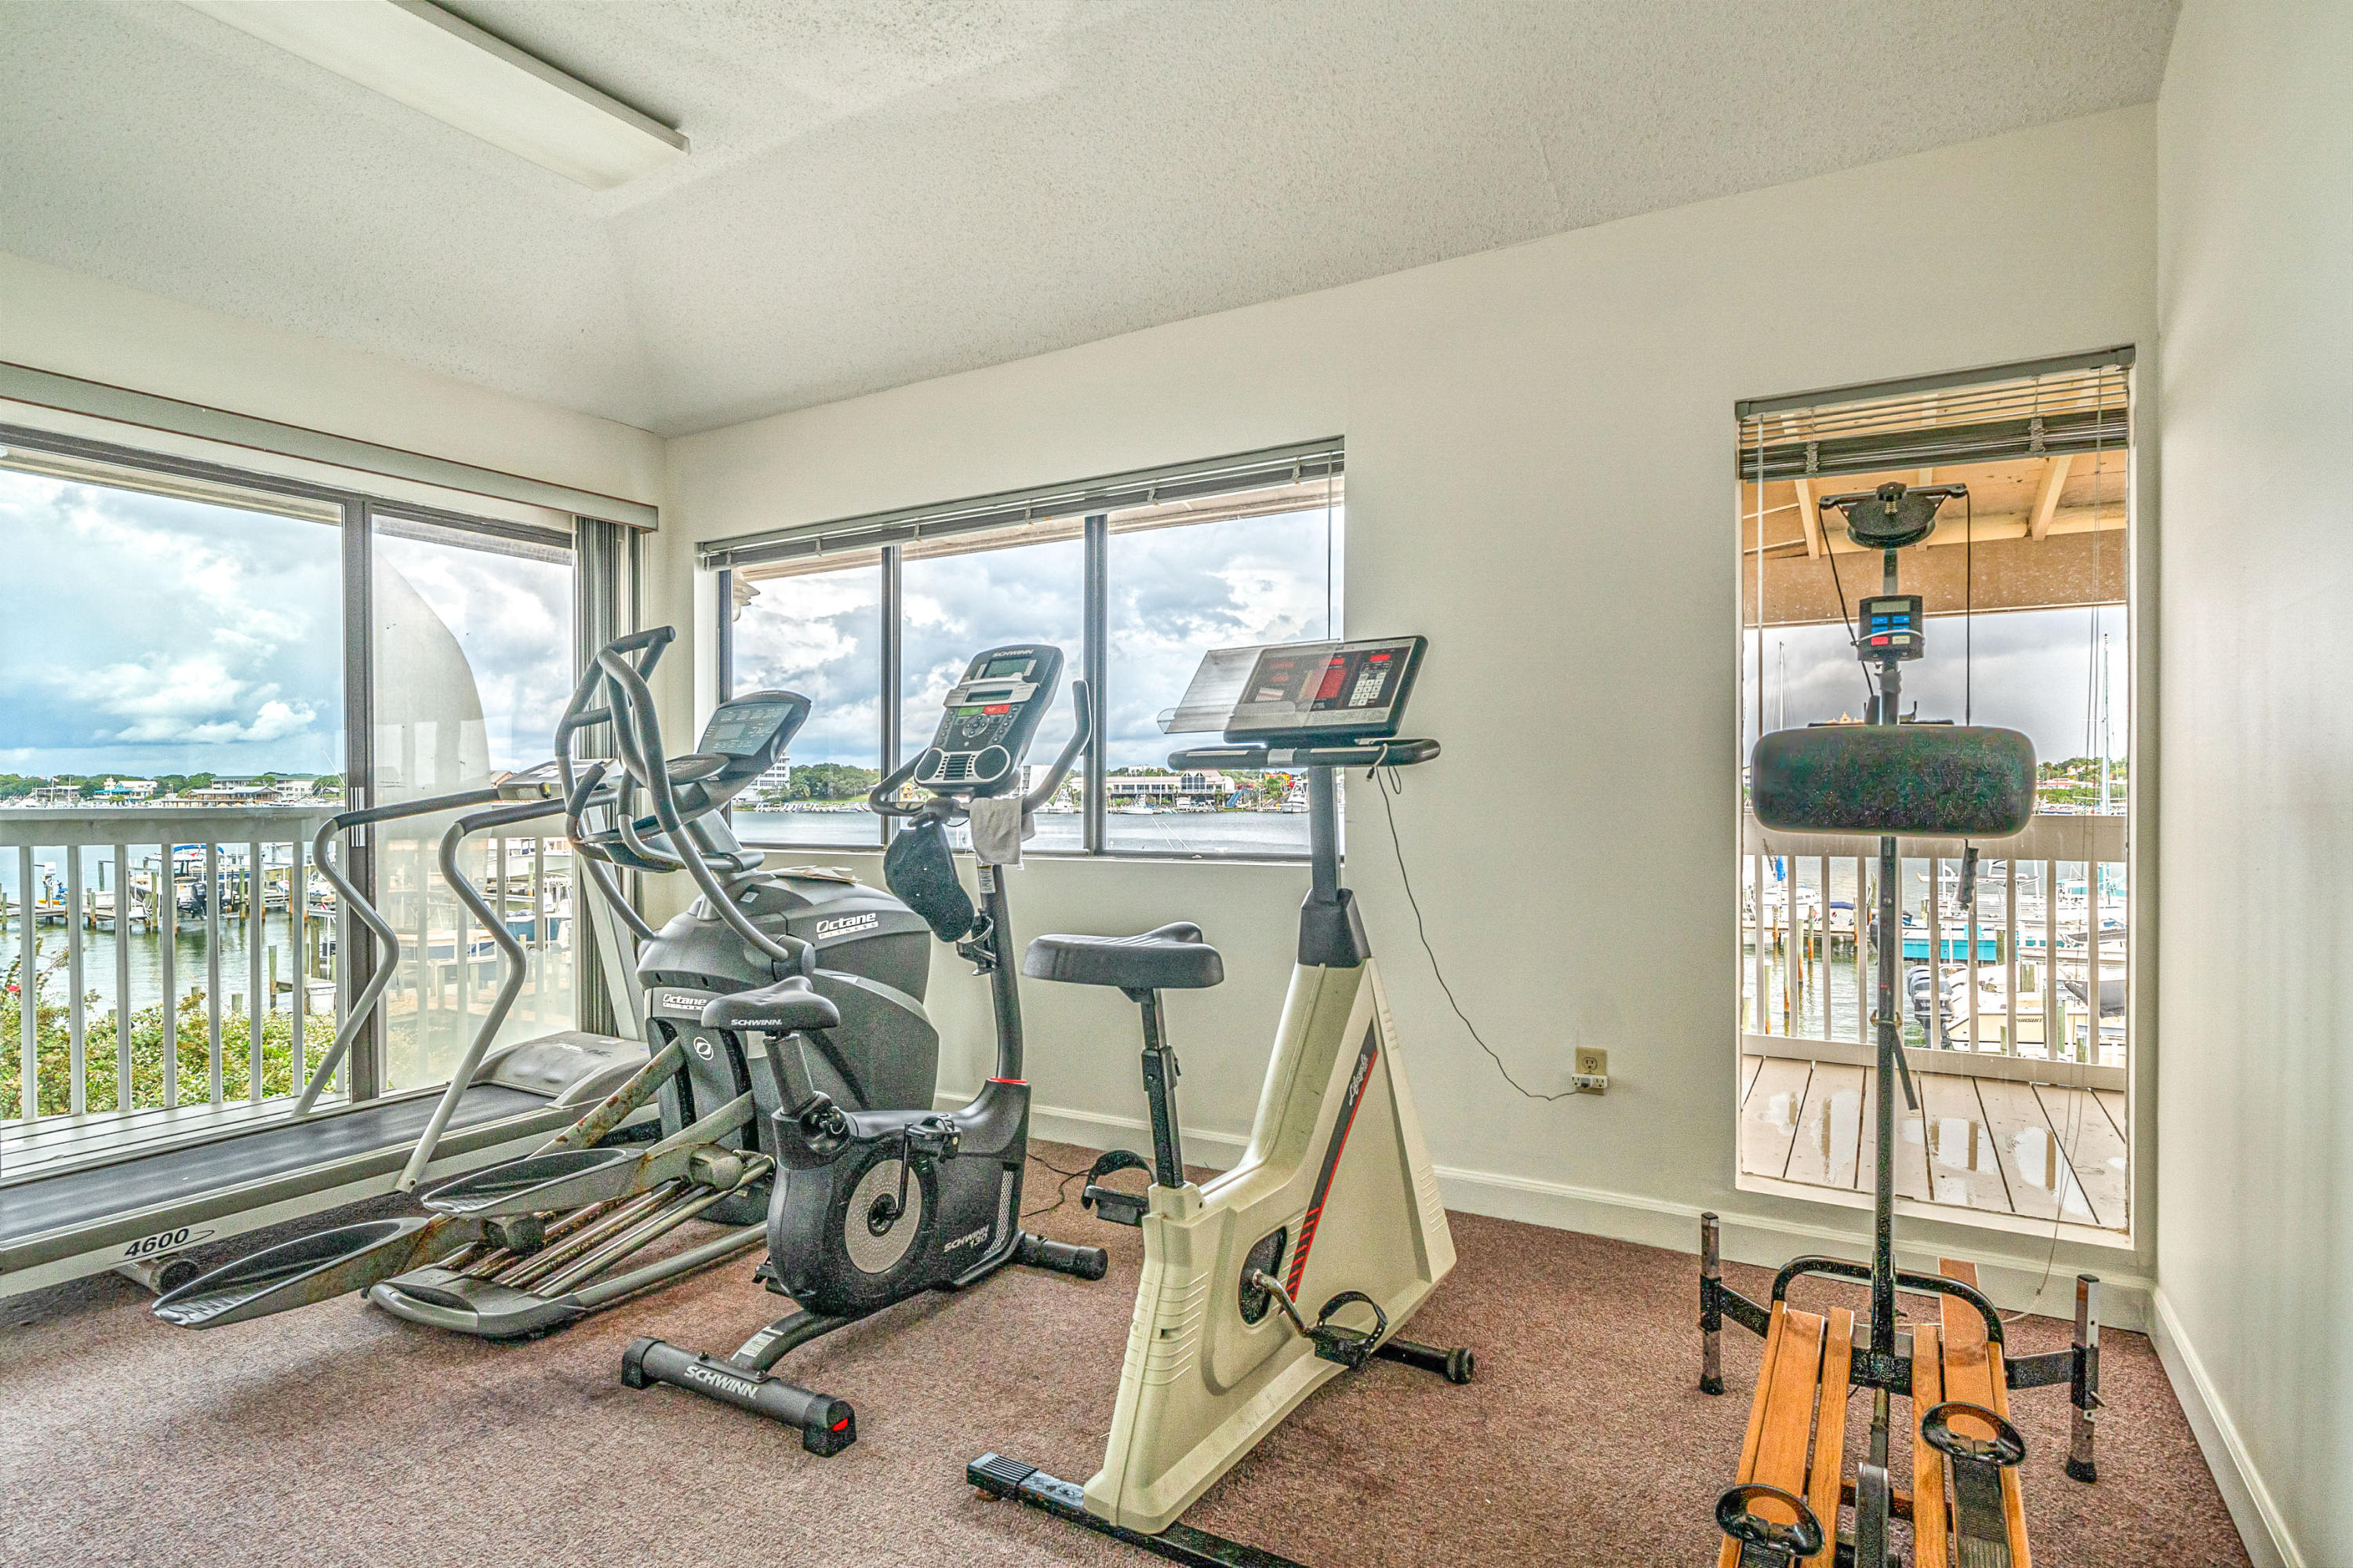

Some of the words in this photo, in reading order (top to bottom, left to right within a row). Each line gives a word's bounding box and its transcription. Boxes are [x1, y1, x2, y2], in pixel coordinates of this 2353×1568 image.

[991, 649, 1034, 657] SCHWINN
[816, 913, 876, 933] Octane
[663, 994, 707, 1006] Octane
[125, 1228, 189, 1257] 4600
[684, 1366, 759, 1399] SCHWINN
